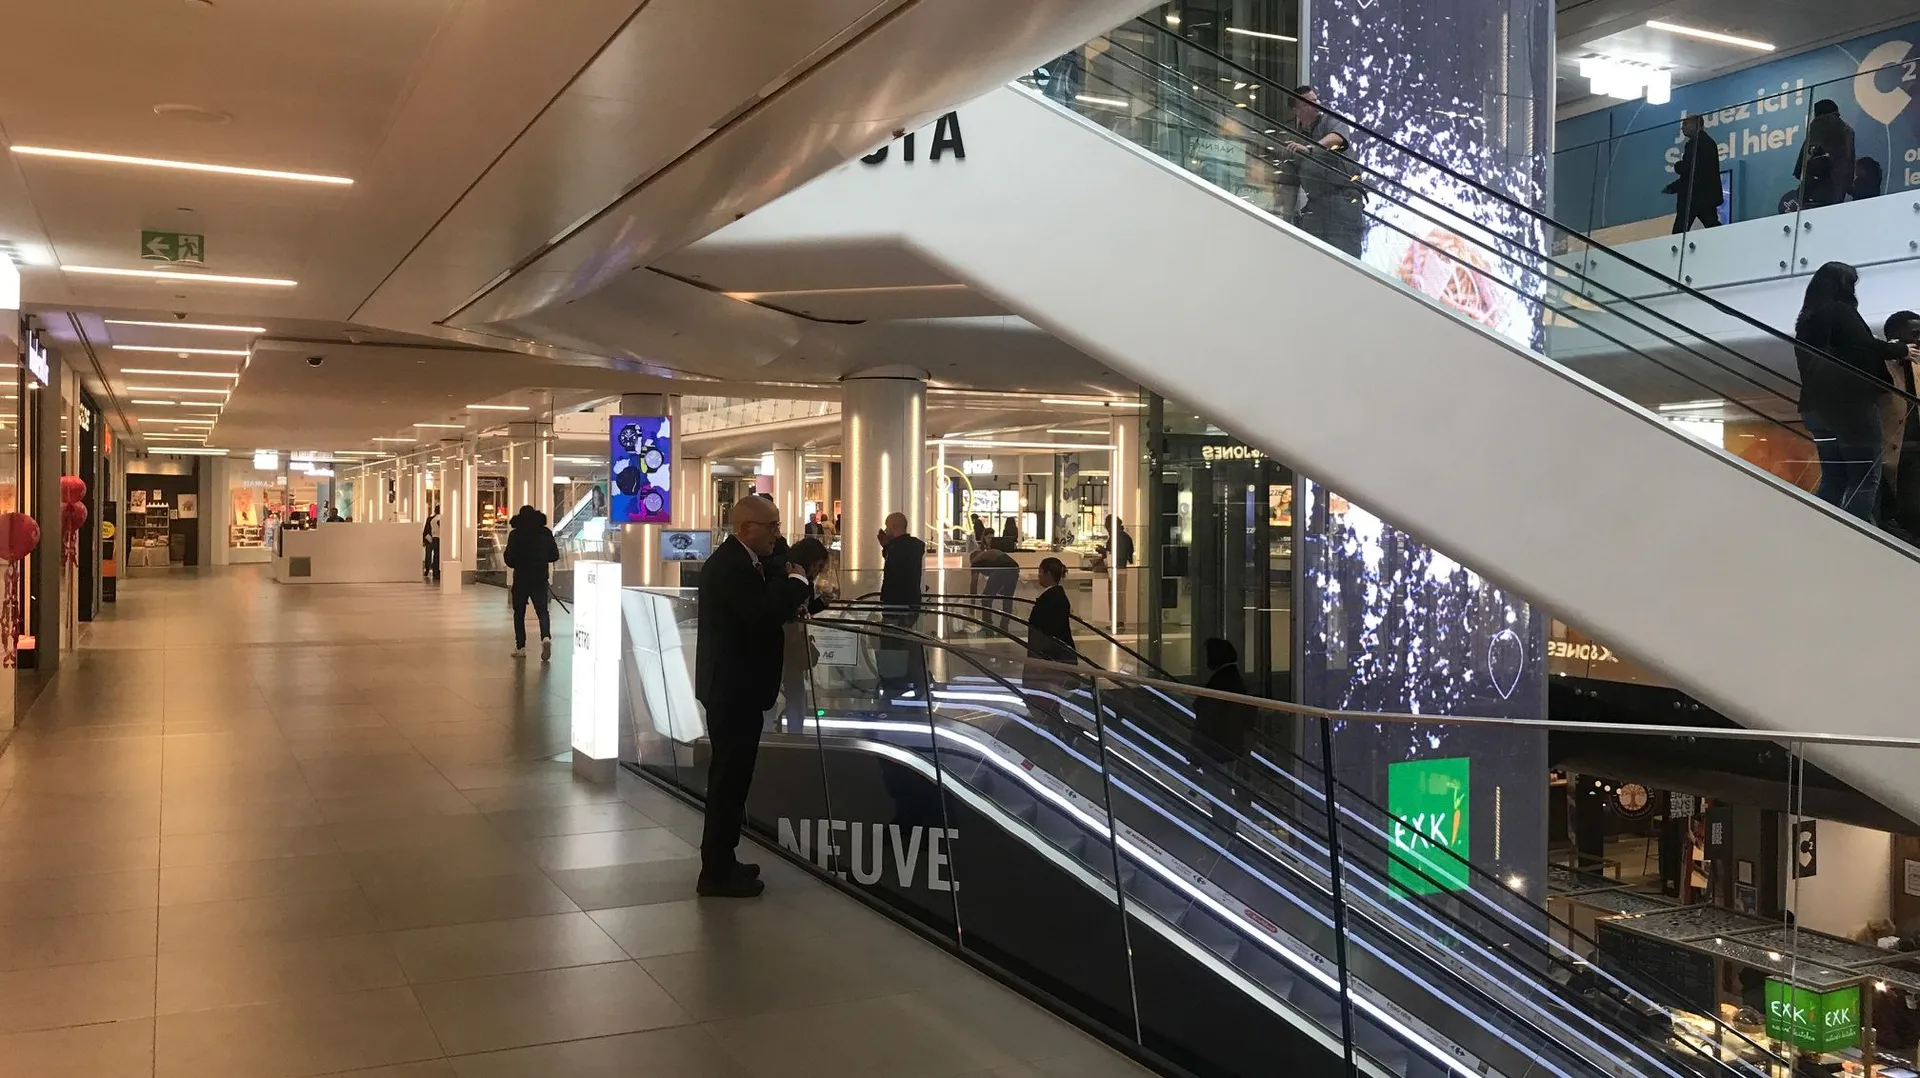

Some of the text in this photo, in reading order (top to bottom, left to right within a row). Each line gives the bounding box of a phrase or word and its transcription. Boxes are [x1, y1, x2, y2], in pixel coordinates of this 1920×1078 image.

[1757, 81, 1789, 115] ici
[1743, 124, 1799, 155] hier
[778, 817, 960, 893] NEUVE
